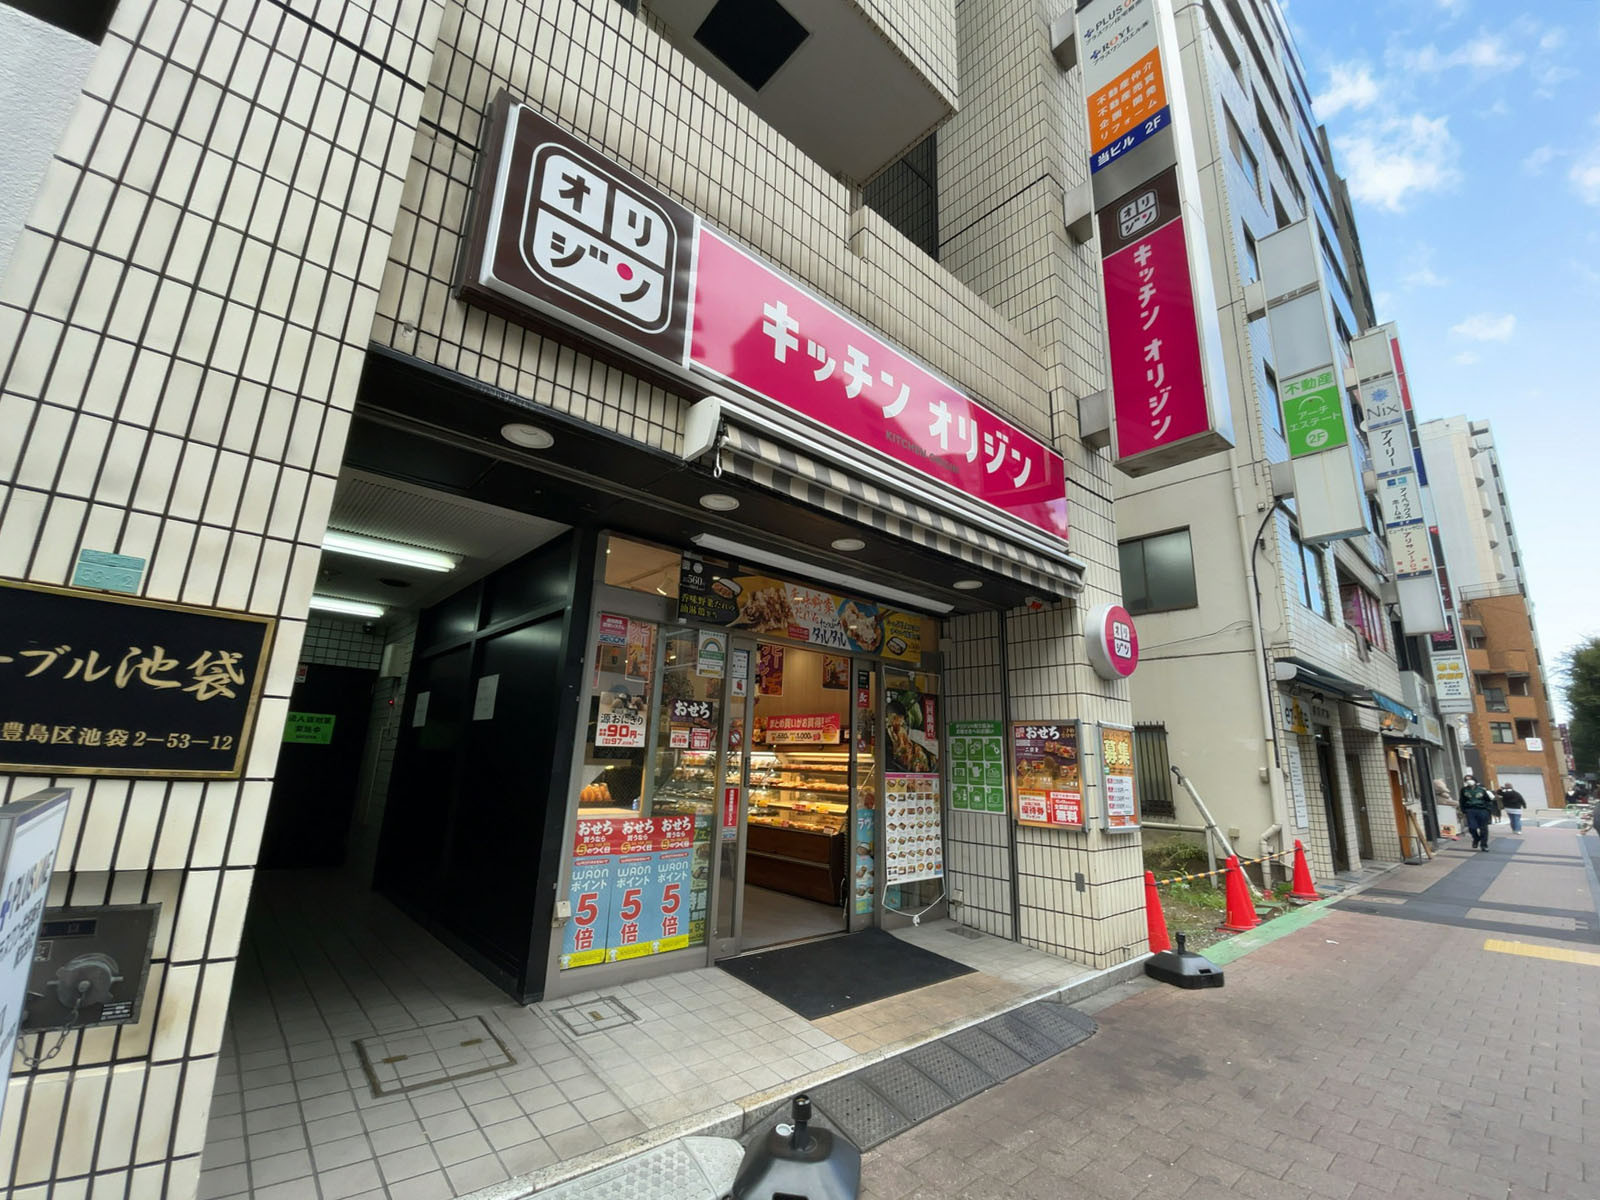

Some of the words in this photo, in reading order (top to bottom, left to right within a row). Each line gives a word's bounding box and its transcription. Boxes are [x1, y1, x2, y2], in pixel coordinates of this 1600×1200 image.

[1101, 99, 1158, 141] リフォーム
[1097, 135, 1135, 167] 当ビル
[1144, 114, 1161, 135] 2F
[1133, 244, 1161, 331] キッチン
[762, 299, 911, 420] キッチン
[928, 400, 1032, 488] オリジン
[1143, 337, 1172, 441] オリジン
[1284, 371, 1334, 395] 不動産
[1288, 412, 1341, 433] エステート
[1297, 404, 1329, 421] アーチ
[1367, 403, 1400, 421] Nix
[885, 429, 928, 458] KITCHEN
[1308, 431, 1326, 444] 2F
[1381, 429, 1395, 467] アイリー
[811, 626, 847, 648] タルタル
[674, 699, 711, 719] おせち
[1026, 726, 1060, 740] おせち
[1103, 738, 1131, 767] 募集
[577, 819, 614, 837] おせち
[621, 818, 655, 835] おせち
[660, 815, 692, 833] おせち
[571, 868, 609, 881] WAON
[617, 864, 652, 877] WAON
[657, 860, 689, 873] WAON
[657, 871, 689, 883] ポイント
[571, 881, 608, 893] ポイント
[616, 876, 651, 889] ポイント
[574, 892, 598, 926] 5
[620, 888, 642, 922] 5
[661, 882, 681, 915] 5
[620, 922, 639, 945] 倍
[661, 915, 679, 938] 倍
[574, 927, 594, 951] 倍
